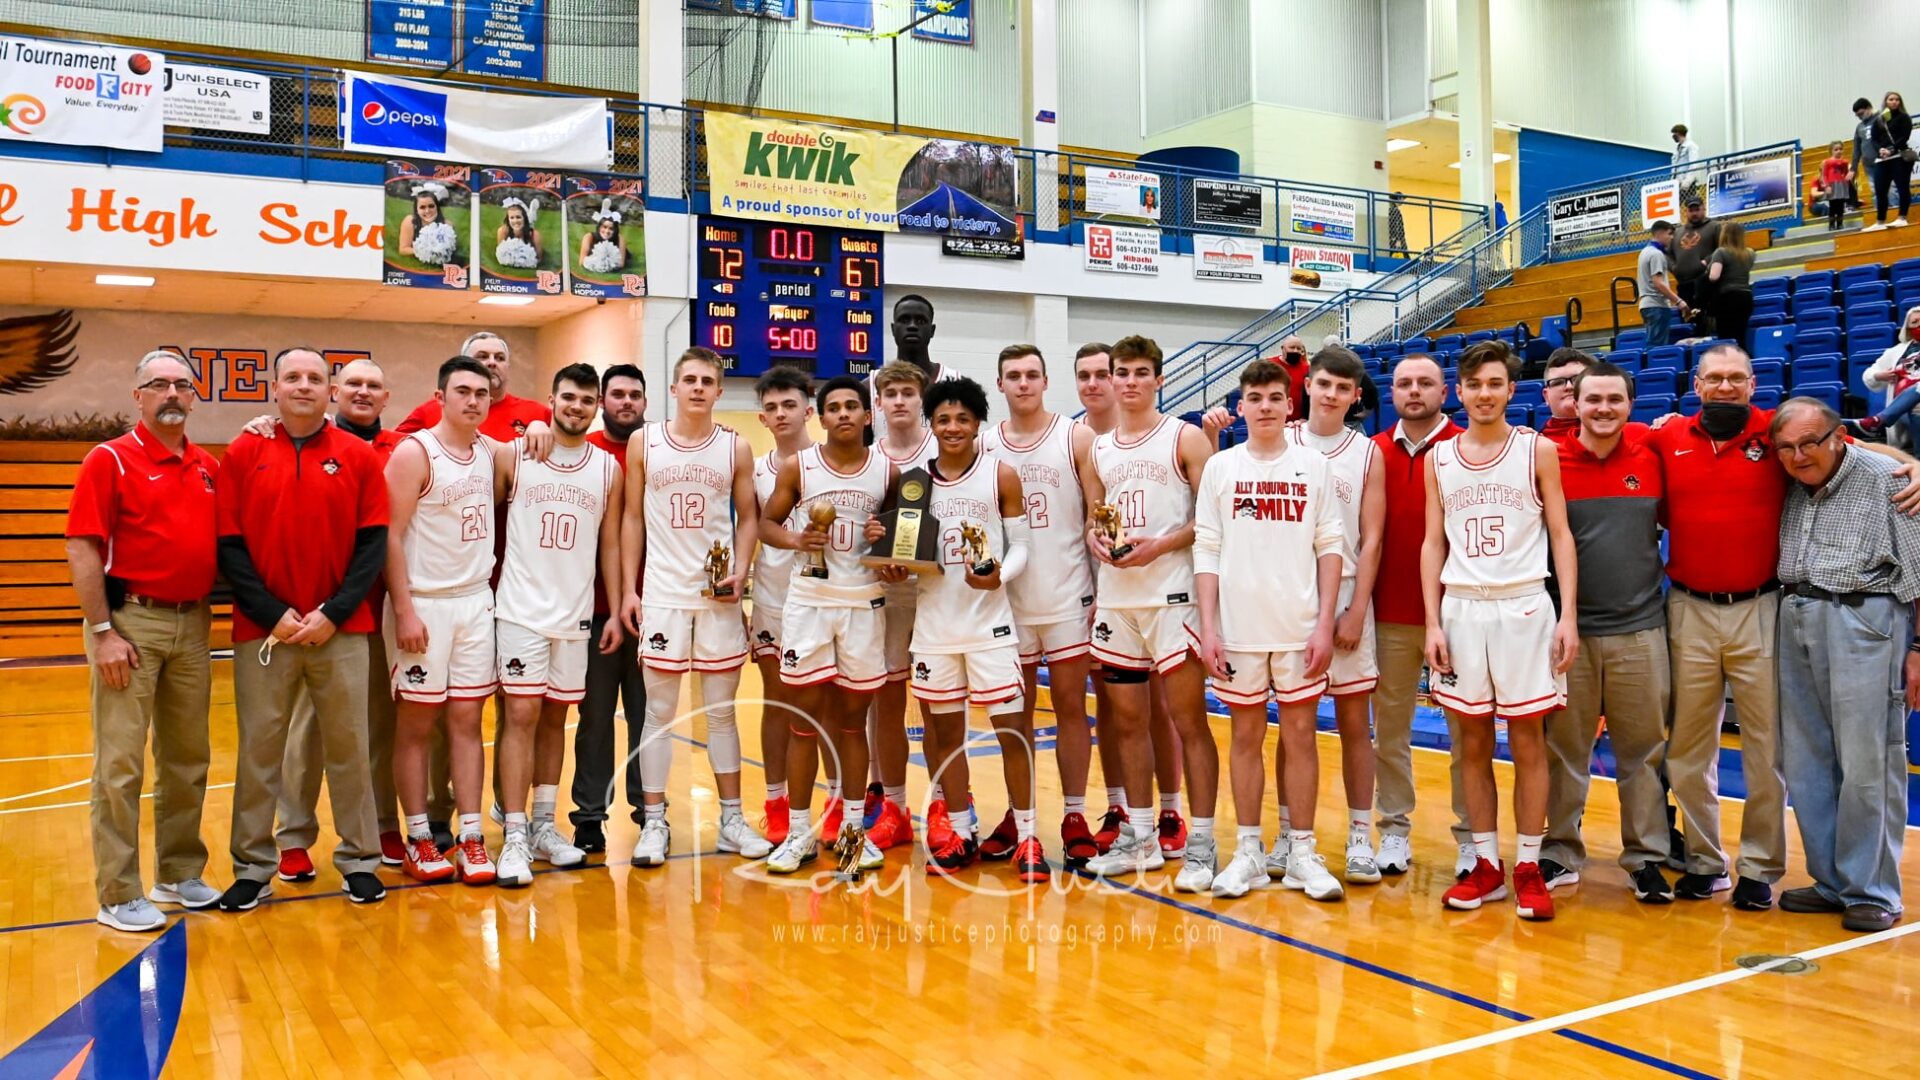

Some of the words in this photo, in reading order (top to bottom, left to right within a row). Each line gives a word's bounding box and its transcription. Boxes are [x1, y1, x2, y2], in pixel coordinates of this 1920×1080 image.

[15, 43, 117, 71] Tournament
[55, 75, 96, 91] FOOD
[121, 81, 152, 97] CITY
[175, 73, 261, 90] UNI-SELECT
[197, 88, 231, 98] USA
[389, 110, 438, 127] pepsi
[767, 130, 817, 147] double
[433, 165, 471, 181] 2021
[526, 172, 562, 189] 2021
[609, 179, 642, 195] 2021
[735, 180, 767, 190] smiles
[772, 181, 794, 194] that
[799, 184, 818, 195] last
[1645, 184, 1675, 193] SECTION
[722, 195, 732, 208] A
[736, 199, 781, 213] proud
[786, 203, 842, 217] sponsor
[847, 208, 861, 219] of
[864, 212, 897, 224] your
[899, 213, 931, 227] road
[934, 214, 949, 228] to
[951, 216, 1001, 236] victory.
[1553, 201, 1573, 216] Gary
[1574, 199, 1583, 211] C.
[1584, 194, 1618, 211] Johnson
[1646, 191, 1674, 220] E
[66, 187, 217, 247] High
[705, 226, 738, 241] Home
[771, 229, 814, 260] 0.0
[841, 237, 878, 253] Guests
[946, 240, 1021, 252] 874-4262
[708, 247, 743, 280] 72
[845, 257, 880, 287] 67
[1292, 248, 1316, 267] PENN
[1318, 250, 1351, 272] STATION
[387, 277, 412, 286] LOWE
[484, 284, 529, 293] ANDERSON
[574, 288, 605, 296] HOPSON
[775, 283, 811, 297] period
[709, 302, 736, 317] fouls
[847, 310, 872, 324] fouls
[713, 325, 733, 347] 10
[768, 327, 816, 350] 5-00
[850, 331, 868, 353] 10
[849, 360, 871, 374] bout
[652, 464, 725, 492] PIRATES
[1255, 481, 1290, 495] AROUND
[1291, 482, 1308, 497] THE
[525, 482, 597, 514] PIRATES
[1118, 489, 1146, 529] 11
[1445, 483, 1524, 517] PIRATES
[670, 492, 705, 529] 12
[461, 504, 488, 542] 21
[540, 511, 578, 551] 10
[1464, 515, 1505, 558] 15
